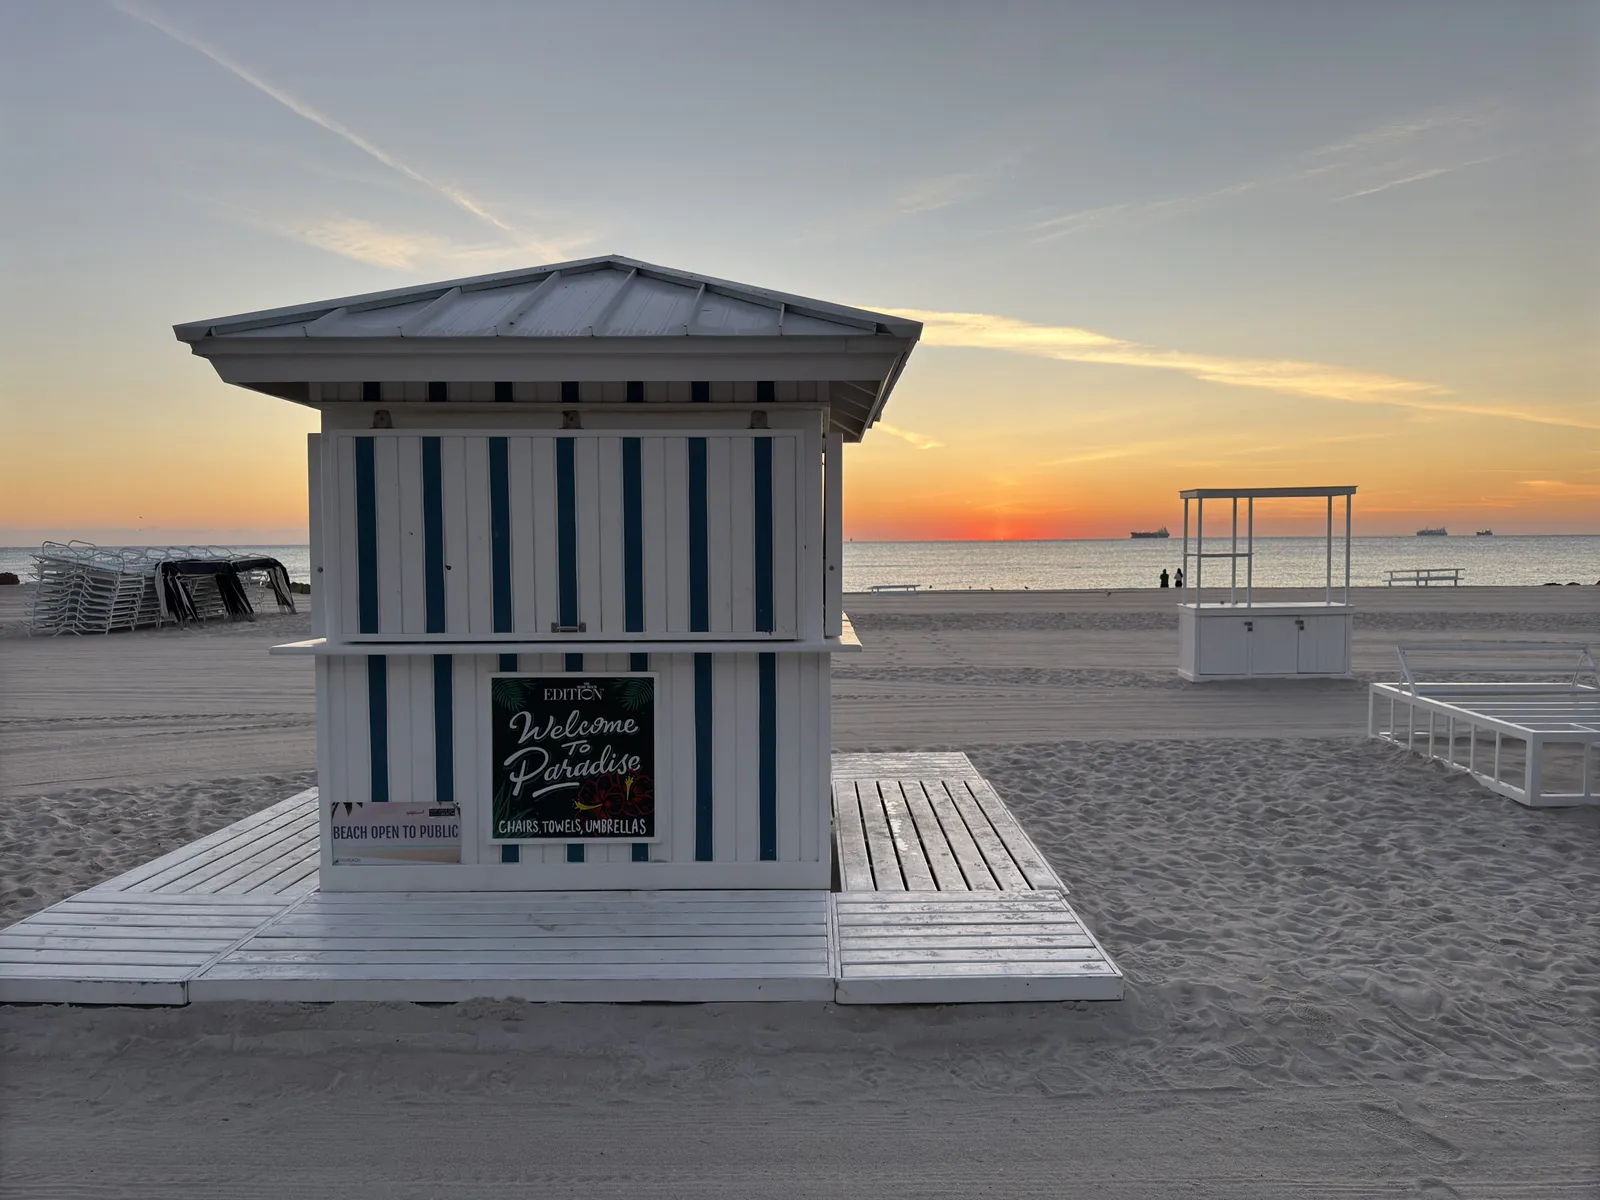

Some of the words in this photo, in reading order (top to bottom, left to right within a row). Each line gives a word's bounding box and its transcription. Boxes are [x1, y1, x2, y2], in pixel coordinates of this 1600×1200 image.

[544, 688, 605, 701] EDITION
[509, 709, 639, 744] Welcome
[561, 739, 591, 756] To
[503, 744, 641, 797] Paradise
[333, 825, 368, 840] BEACH
[371, 825, 400, 839] OPEN
[402, 825, 417, 839] TO
[420, 824, 459, 839] PUBLIC
[499, 819, 541, 835] CHAIRS,
[542, 818, 583, 835] TOWELS,
[585, 818, 647, 835] UMBRELLAS
